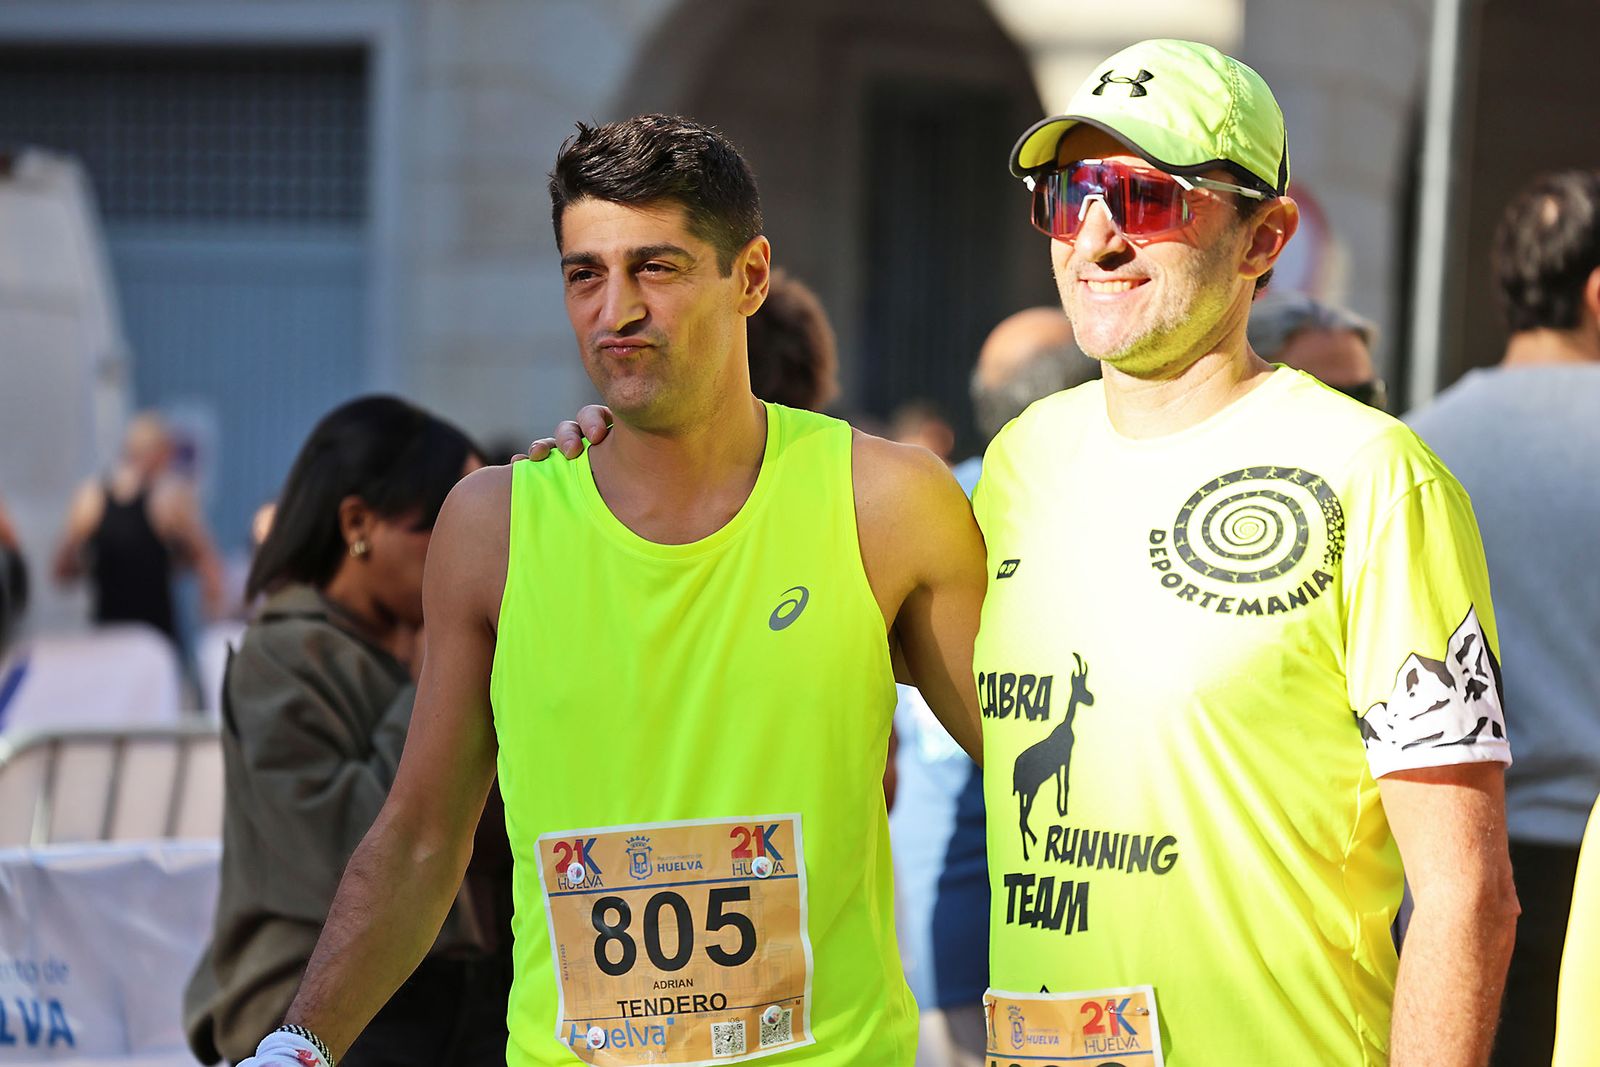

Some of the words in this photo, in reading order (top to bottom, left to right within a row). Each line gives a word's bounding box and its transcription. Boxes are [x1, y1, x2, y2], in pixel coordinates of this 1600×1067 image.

[1149, 529, 1334, 616] DEPORTEMANIA
[978, 671, 1053, 722] CABRA
[553, 837, 602, 874] 21K
[730, 823, 784, 858] 21K
[1044, 825, 1179, 875] RUNNING
[657, 861, 703, 873] HUELVA
[732, 861, 785, 876] HUA
[1004, 873, 1090, 935] TEAM
[591, 886, 757, 977] 805
[653, 979, 694, 990] ADRIAN
[617, 993, 728, 1019] TENDERO
[1080, 998, 1138, 1036] 21K
[1026, 1035, 1059, 1045] HUELVA
[1084, 1036, 1140, 1053] HUELVA
